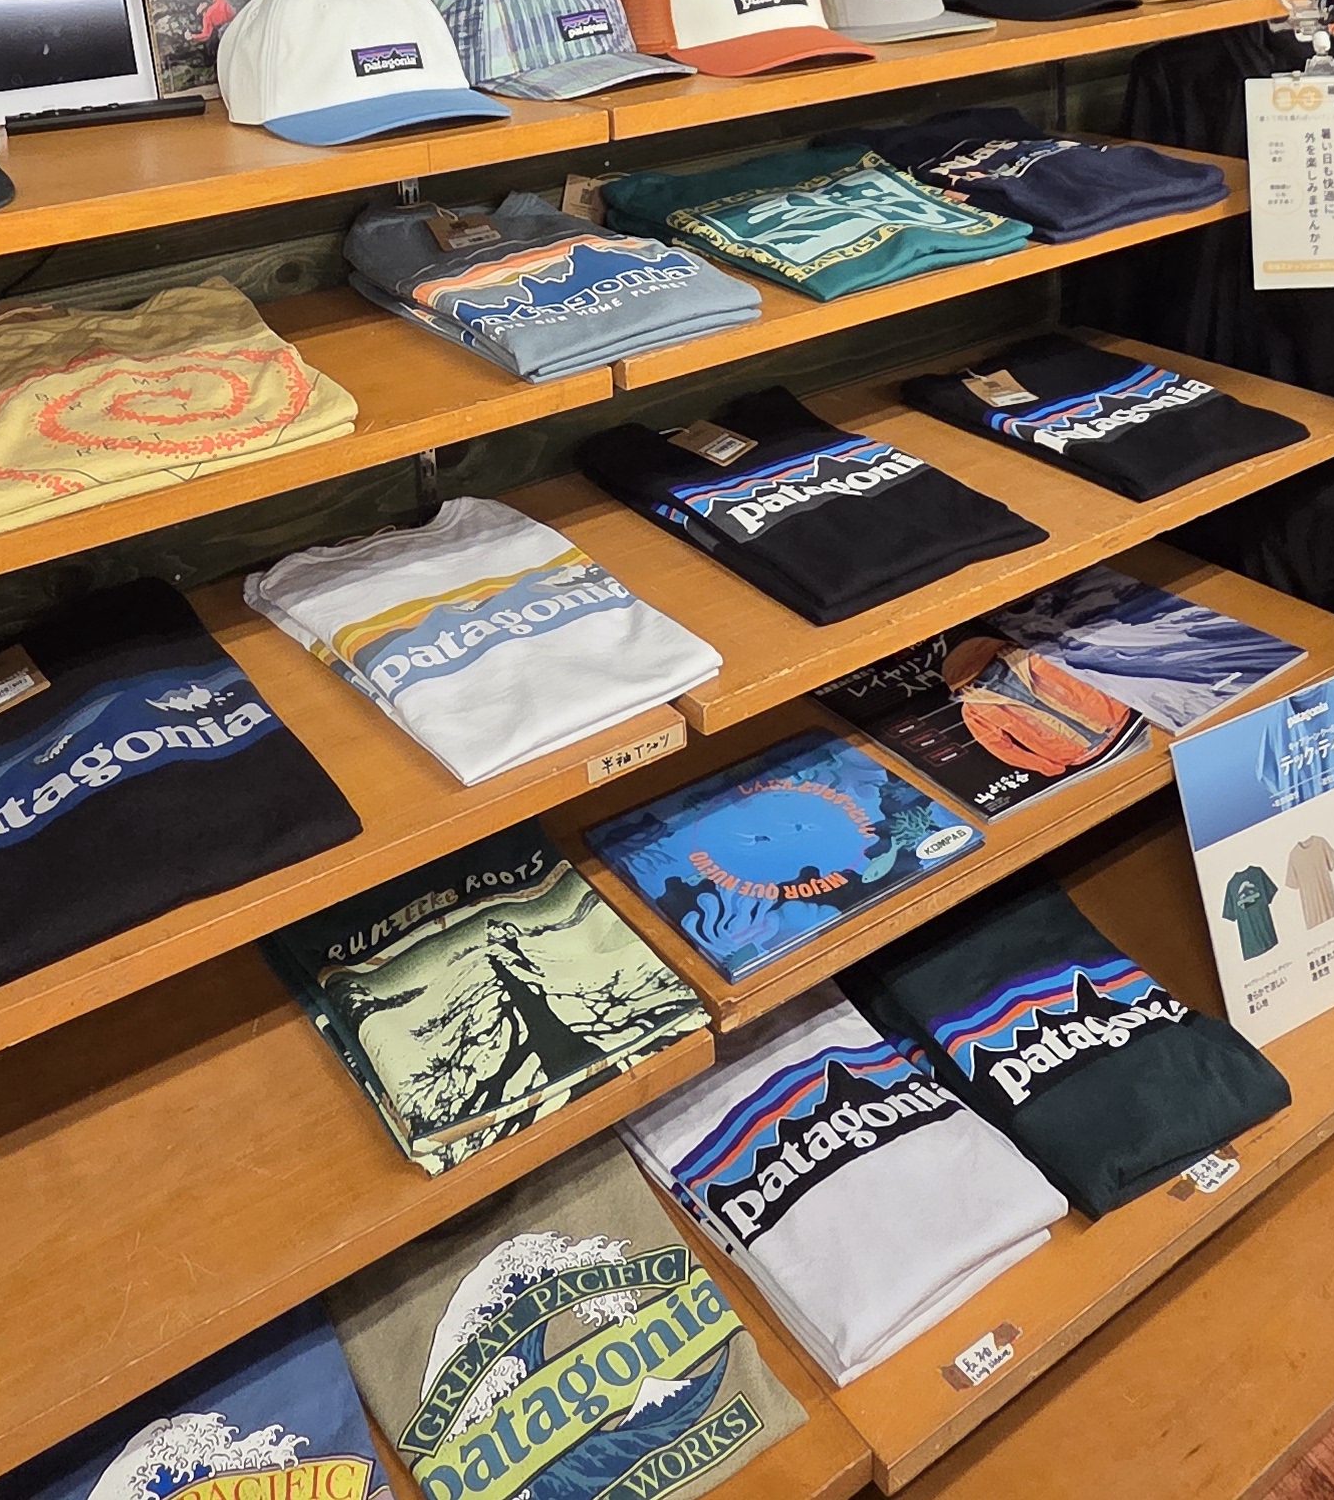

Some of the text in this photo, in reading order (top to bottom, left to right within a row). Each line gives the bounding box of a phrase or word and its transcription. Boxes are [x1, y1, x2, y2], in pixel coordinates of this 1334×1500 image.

[568, 23, 609, 39] patagonia
[363, 56, 418, 73] patagonia
[577, 298, 623, 317] HOME
[631, 281, 689, 298] PLANET
[727, 451, 924, 534] patagoni
[368, 575, 634, 699] patagonia
[847, 634, 947, 697] レイヤリング
[897, 670, 945, 697] 入門
[1287, 702, 1329, 728] patagonia
[602, 733, 670, 774] 半袖Tシャツ
[466, 850, 544, 893] ROOTS
[688, 850, 849, 900] MEJOR QUE NUEVO
[414, 1253, 677, 1441] GREAT PACIFIC
[421, 1270, 733, 1500] patagonia
[623, 1409, 749, 1500] WORKS
